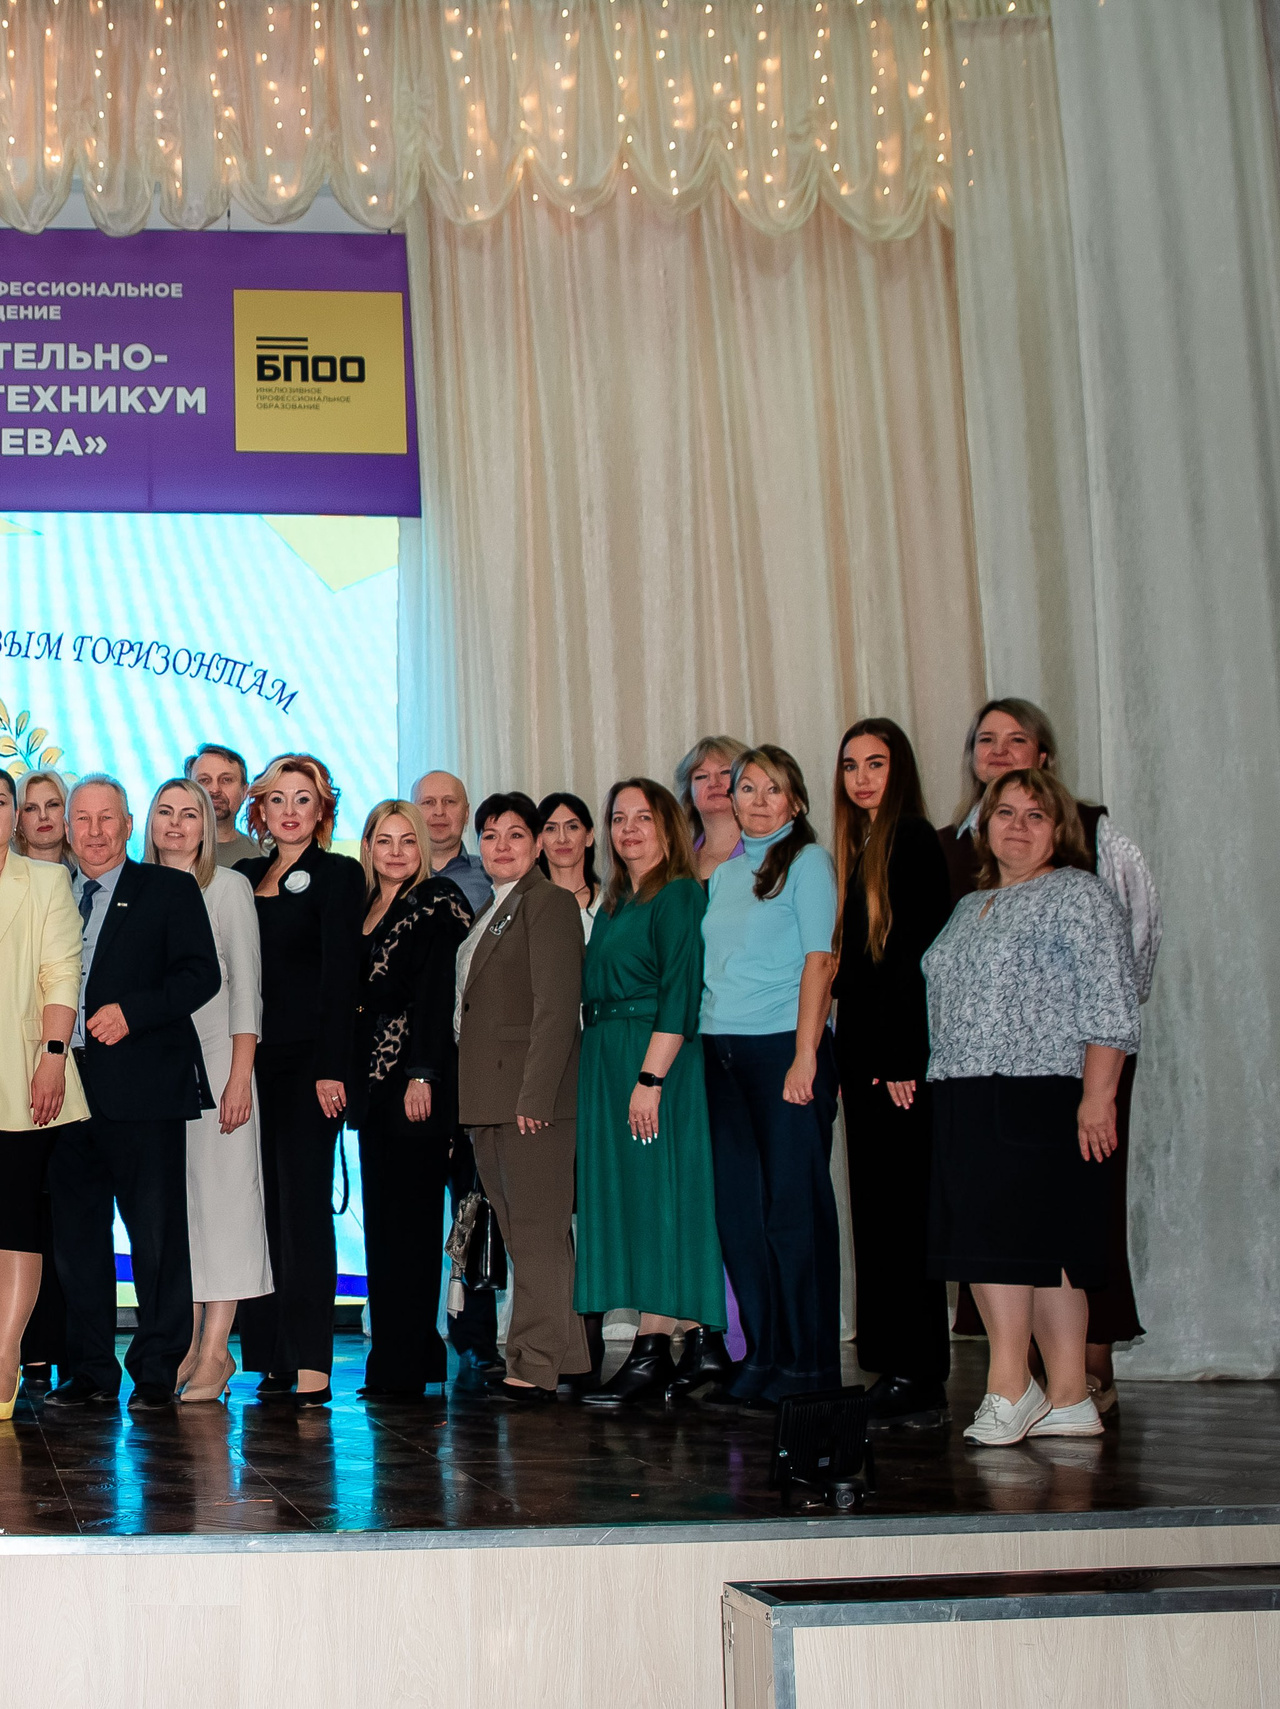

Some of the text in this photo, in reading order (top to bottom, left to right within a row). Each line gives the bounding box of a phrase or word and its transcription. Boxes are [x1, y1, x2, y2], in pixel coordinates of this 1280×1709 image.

[256, 354, 366, 384] БПОО
[256, 394, 351, 403] ПРОФЕССИОНАЛЬНОЕ
[256, 402, 320, 410] ОБРАЗОВАНИЕ
[72, 634, 300, 716] ГОРИЗОНТАМ
